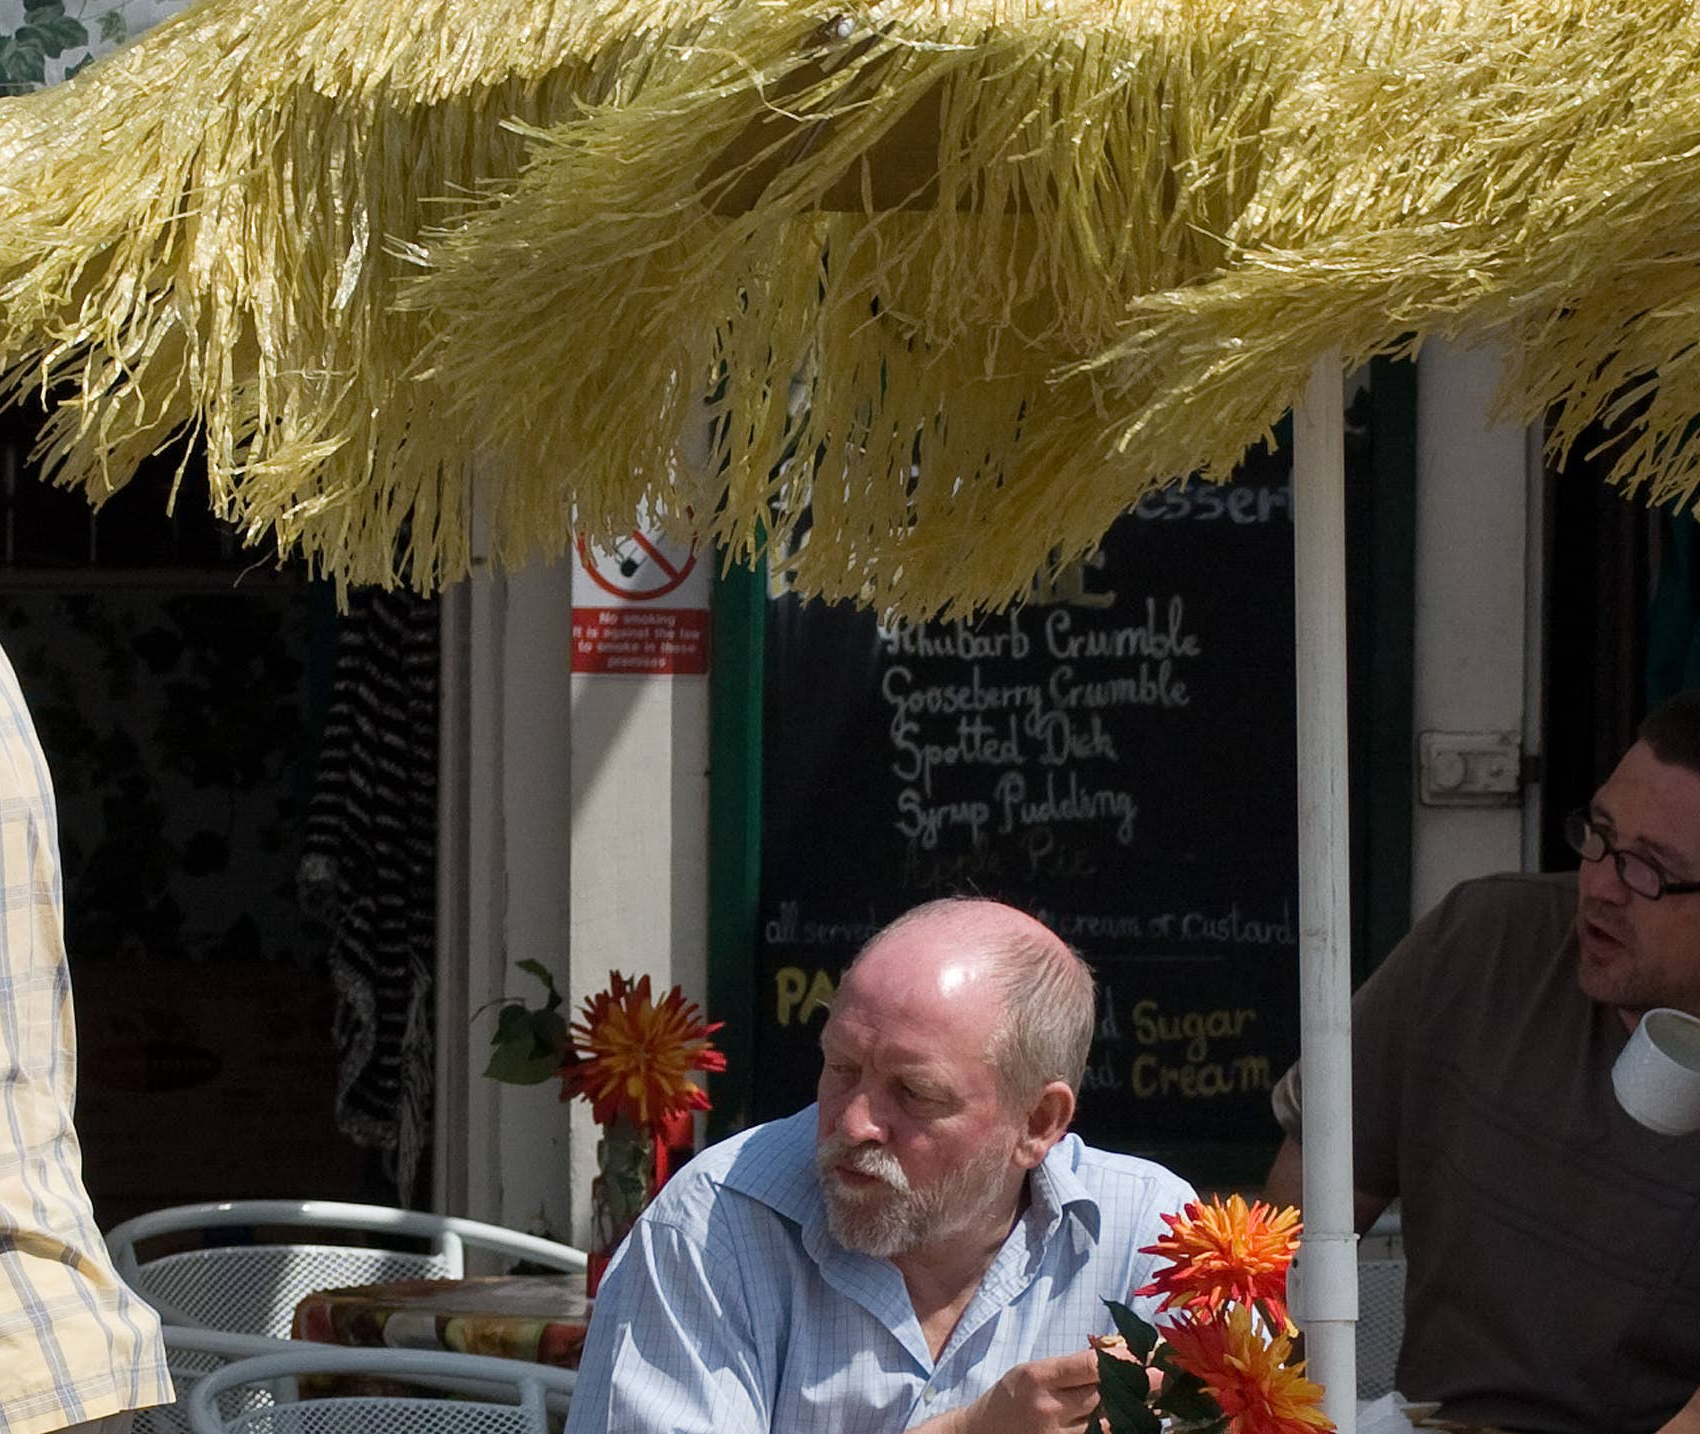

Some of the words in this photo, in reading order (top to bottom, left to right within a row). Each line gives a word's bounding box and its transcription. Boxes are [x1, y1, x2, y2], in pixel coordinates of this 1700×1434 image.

[886, 605, 1030, 661] Rhubarb
[1045, 594, 1201, 660] Crumble
[882, 664, 1046, 738] Gooseberry
[1049, 658, 1193, 709] Crumble
[891, 712, 1028, 798] Spotted
[1037, 709, 1120, 766] Dick
[894, 787, 991, 849] Syrup
[993, 769, 1139, 846] Pudding
[765, 901, 799, 944] all
[775, 965, 836, 1028] PA
[1131, 998, 1260, 1063] Sugar
[1131, 1053, 1273, 1100] Cream
